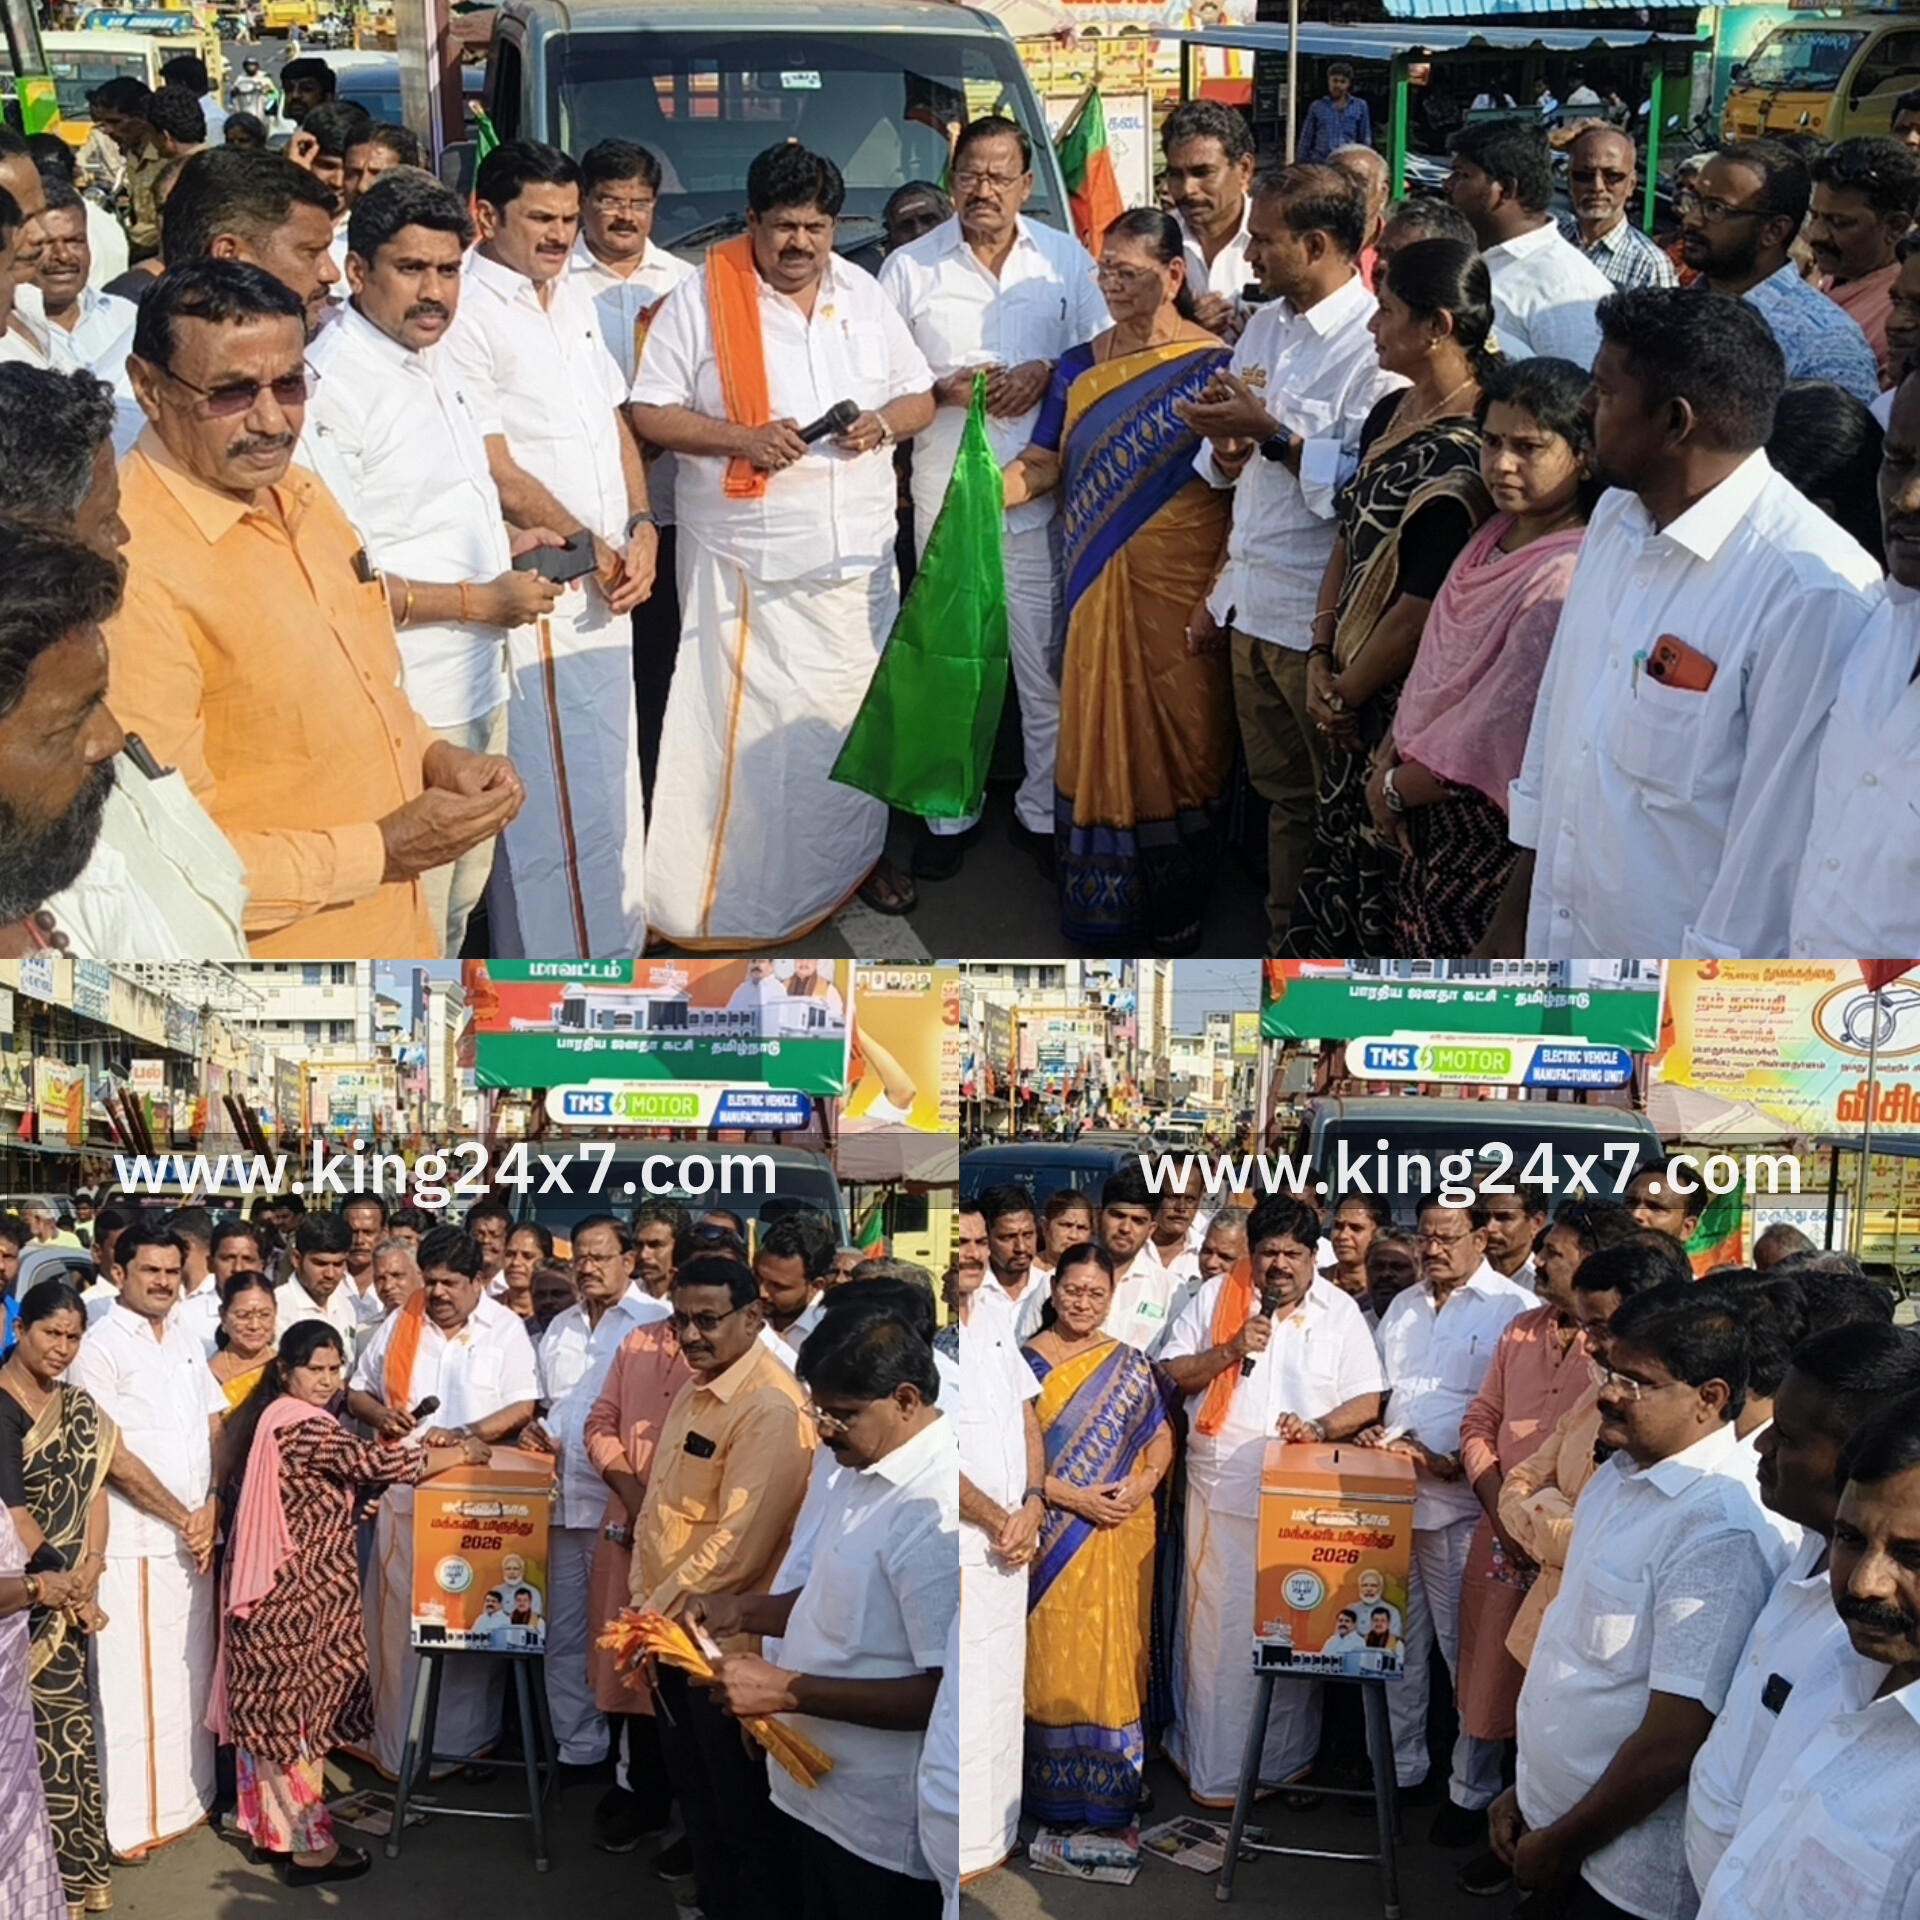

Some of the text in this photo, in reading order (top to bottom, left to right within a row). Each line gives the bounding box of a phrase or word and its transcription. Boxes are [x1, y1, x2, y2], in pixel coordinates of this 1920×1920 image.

[1349, 985, 1402, 1000] பாரதிய
[1407, 987, 1458, 1004] ஜனதா
[1463, 988, 1497, 1002] கட்சி
[1514, 989, 1590, 1008] தமிழ்நாடு
[557, 1037, 607, 1052] பாரதிய
[611, 1039, 658, 1054] ஜனதா
[662, 1040, 695, 1053] கட்சி
[711, 1040, 781, 1057] தமிழ்நாடு
[1369, 1046, 1505, 1070] TMS MOTOR
[1541, 1049, 1618, 1066] ELECTRIC VEHICLE
[1532, 1067, 1625, 1084] MANUFACTURING UNIT
[567, 1095, 693, 1115] TMS MOTOR
[728, 1094, 798, 1107] ELECTRIC VEHICLE
[720, 1110, 804, 1125] MANUFACTURING UNIT
[460, 1534, 503, 1550] 2026
[1311, 1547, 1360, 1565] 2026
